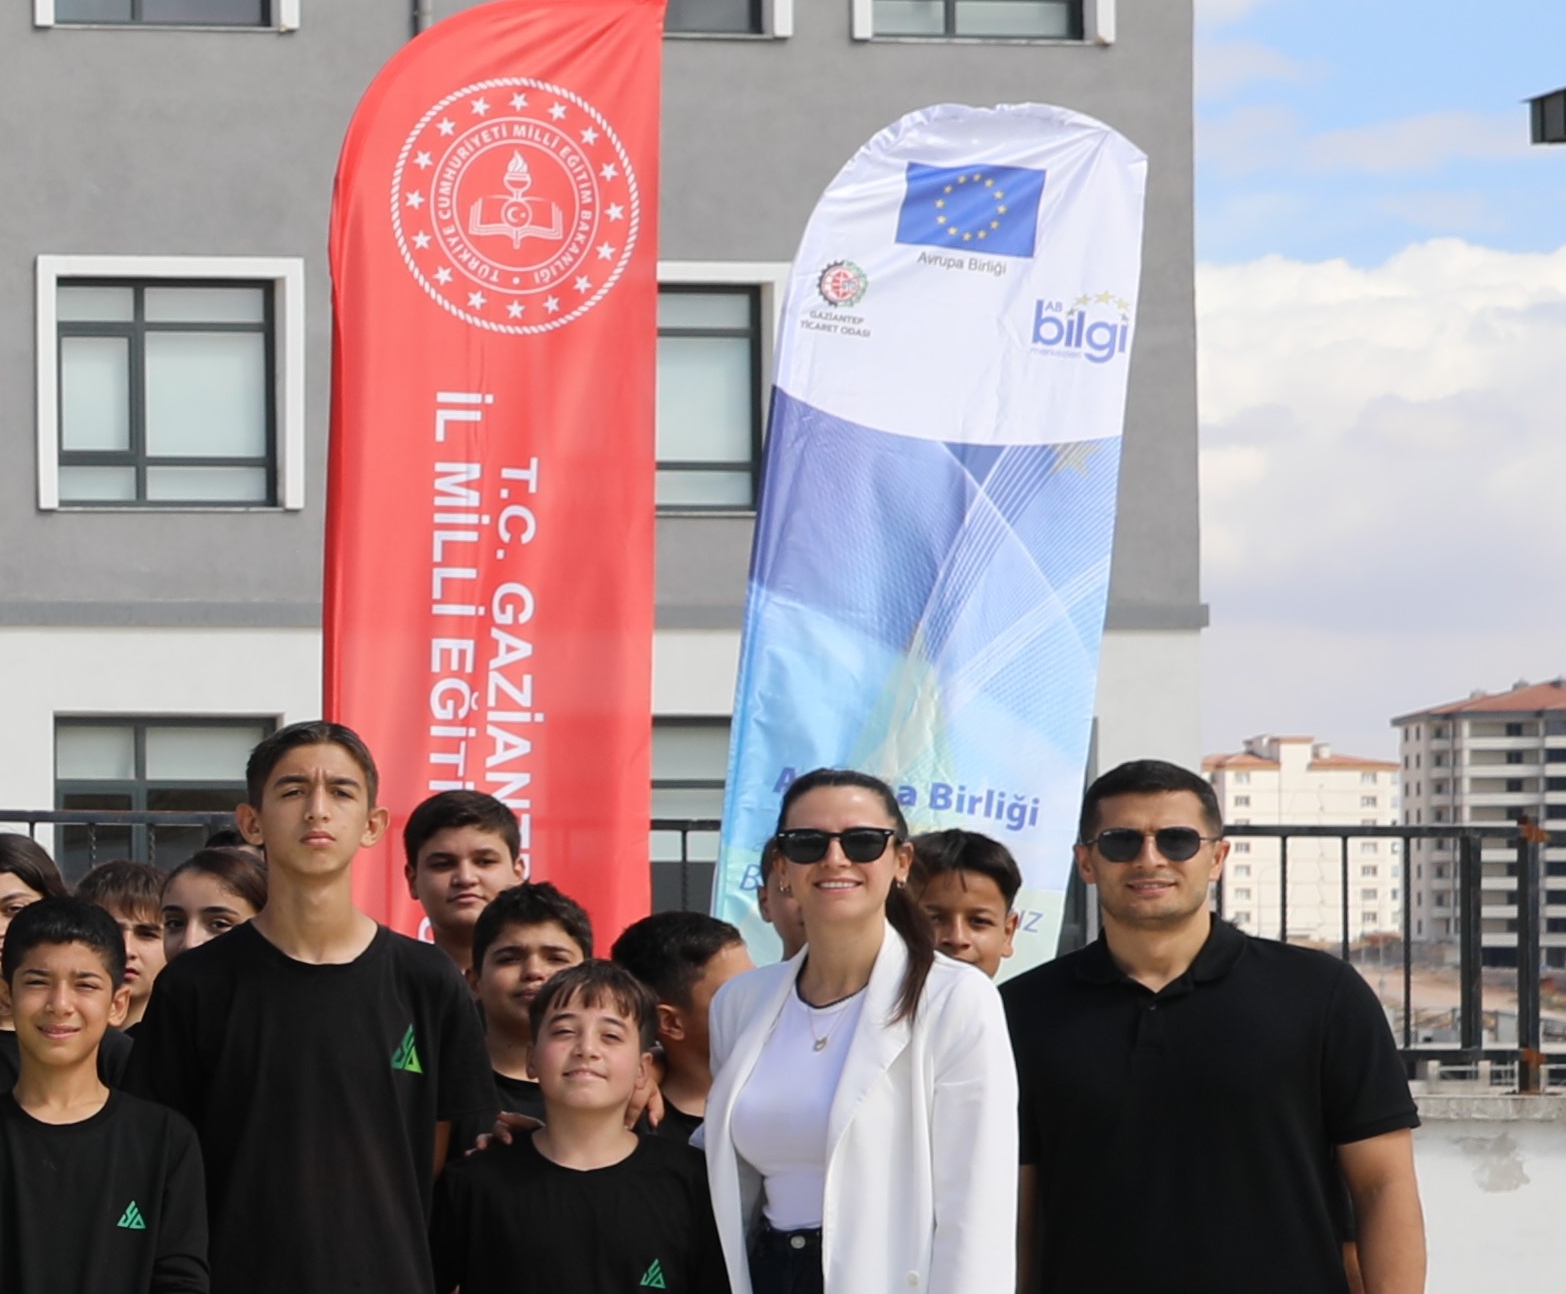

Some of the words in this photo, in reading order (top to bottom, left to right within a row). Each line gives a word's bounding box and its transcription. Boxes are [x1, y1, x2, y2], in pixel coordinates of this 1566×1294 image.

[512, 124, 561, 149] MİLLİ
[437, 123, 508, 220] CUMHURİYETİ
[559, 146, 593, 205] EĞİTİM
[441, 225, 500, 283] TÜRKİYE
[533, 210, 593, 285] BAKANLIĞI
[917, 250, 964, 271] Avrupa
[967, 257, 1007, 277] Birliği
[1031, 298, 1129, 364] bilgi
[1044, 300, 1063, 313] AB
[434, 390, 494, 442] İL
[496, 456, 539, 560] T.C.
[430, 461, 491, 616] MİLLİ
[428, 637, 479, 791] EĞİTİ
[928, 782, 1040, 832] Birliği
